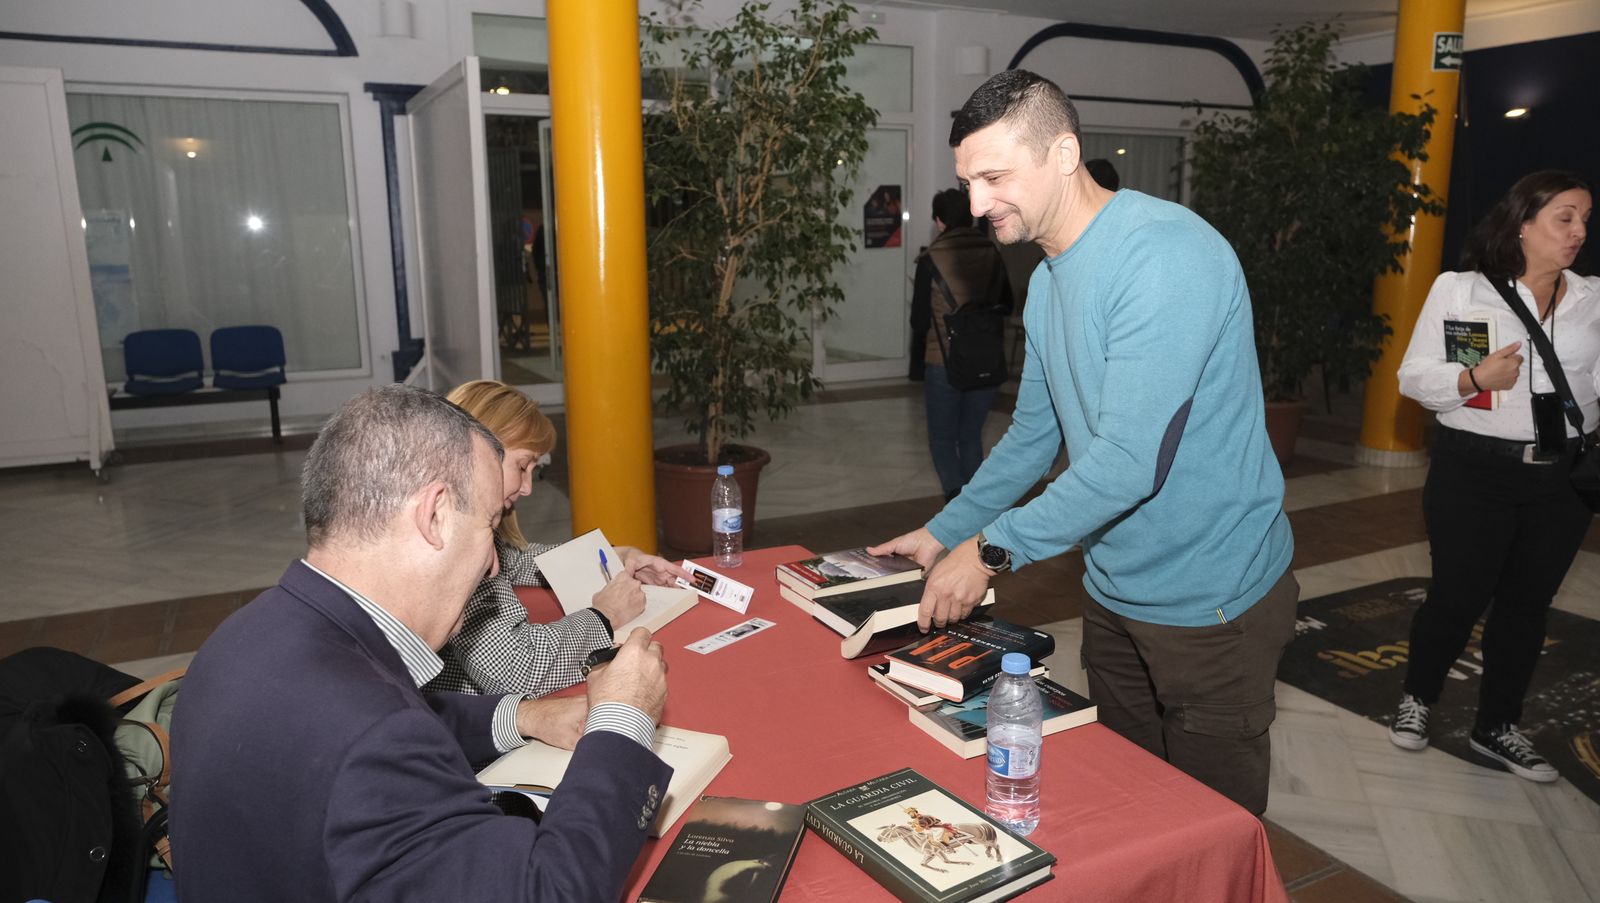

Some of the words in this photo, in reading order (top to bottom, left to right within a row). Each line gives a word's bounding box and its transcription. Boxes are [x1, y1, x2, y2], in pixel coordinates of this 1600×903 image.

[829, 802, 846, 811] LA
[845, 787, 890, 805] GUARDIA
[889, 777, 918, 790] CIVIL
[806, 812, 821, 829] CIVI
[687, 833, 716, 841] Lorenzo
[695, 839, 720, 848] niebla
[822, 824, 853, 854] GUARDIA
[696, 846, 730, 855] doncella
[854, 849, 864, 864] LA
